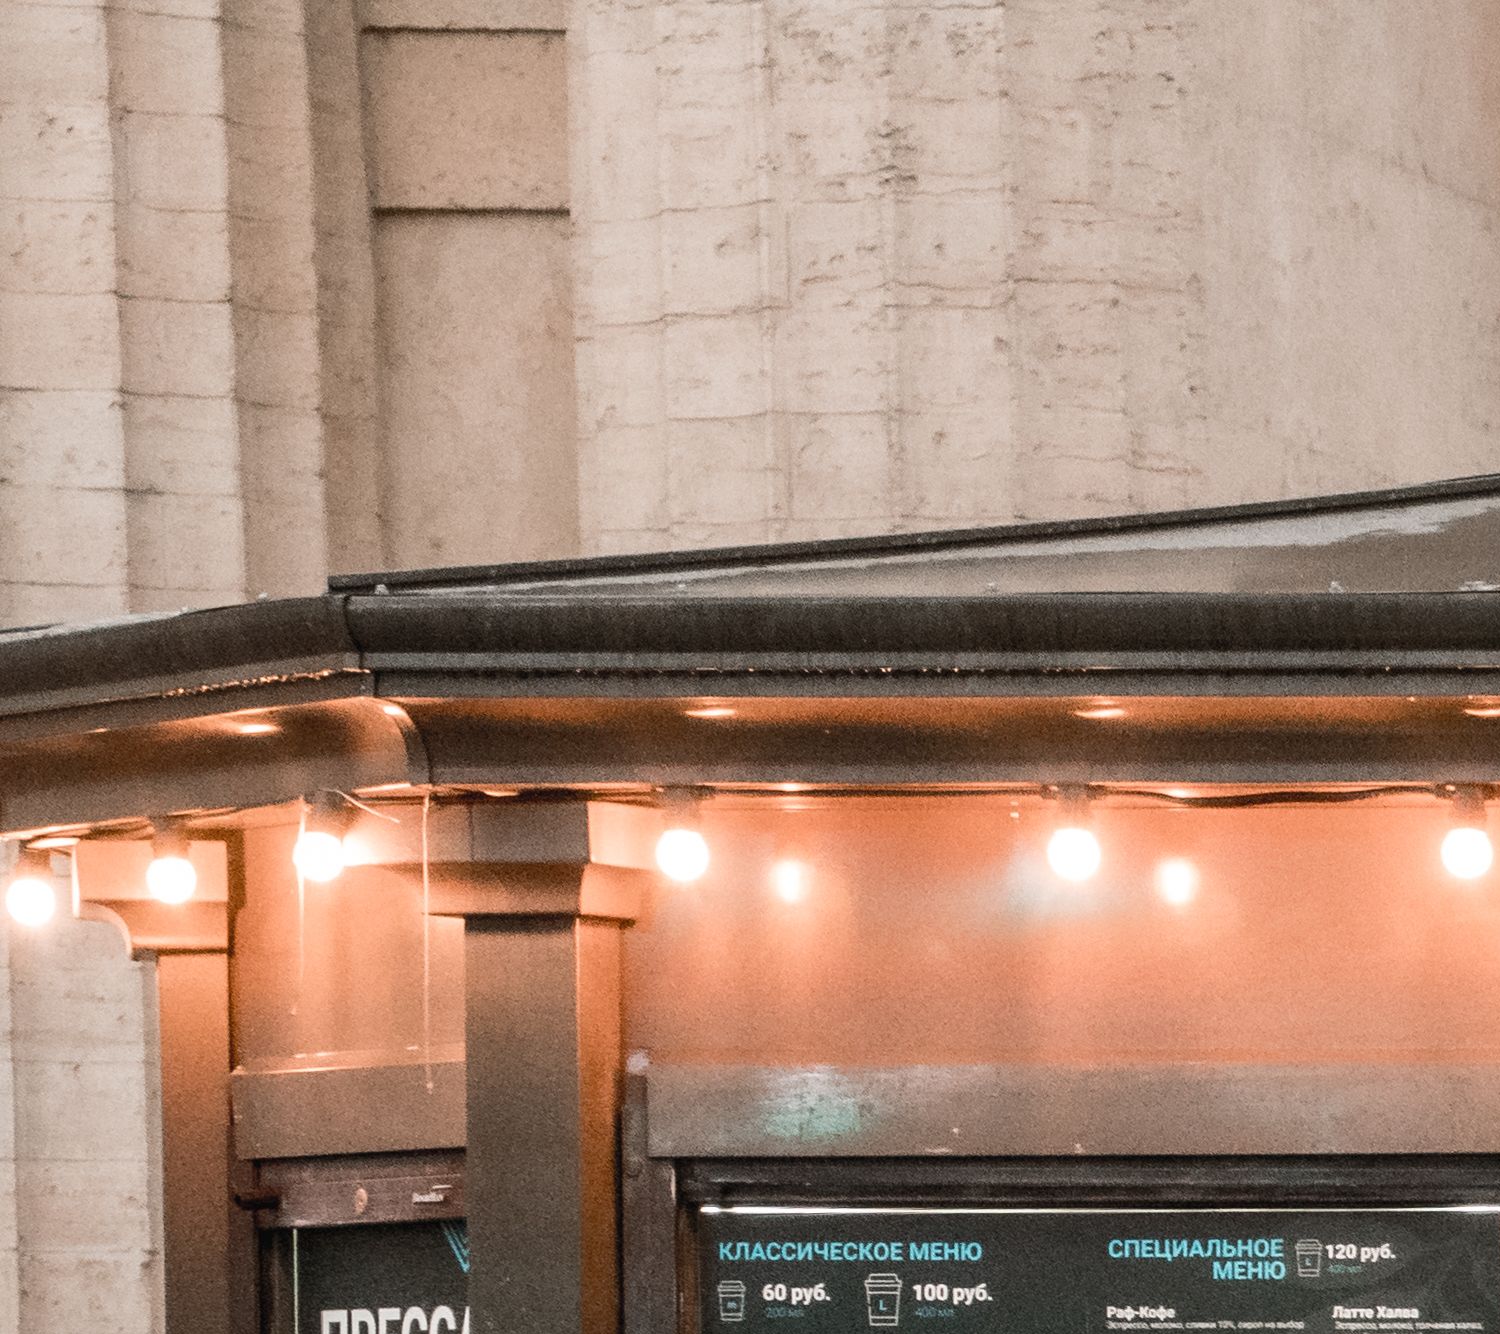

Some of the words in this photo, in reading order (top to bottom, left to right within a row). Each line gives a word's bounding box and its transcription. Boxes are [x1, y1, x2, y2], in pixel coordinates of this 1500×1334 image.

[719, 1242, 903, 1262] КЛАССИЧЕСКОЕ
[908, 1242, 983, 1262] МЕНЮ
[1107, 1238, 1285, 1262] СПЕЦИАЛЬНОЕ
[1325, 1244, 1357, 1260] 120
[1359, 1243, 1397, 1262] руб.
[1212, 1260, 1286, 1281] МЕНЮ
[762, 1284, 787, 1300] 60
[790, 1283, 832, 1305] руб.
[912, 1284, 948, 1300] 100
[952, 1283, 993, 1305] руб.
[1106, 1305, 1176, 1321] Раф-Кофе
[1332, 1306, 1374, 1319] Латте
[1376, 1306, 1419, 1319] Халва
